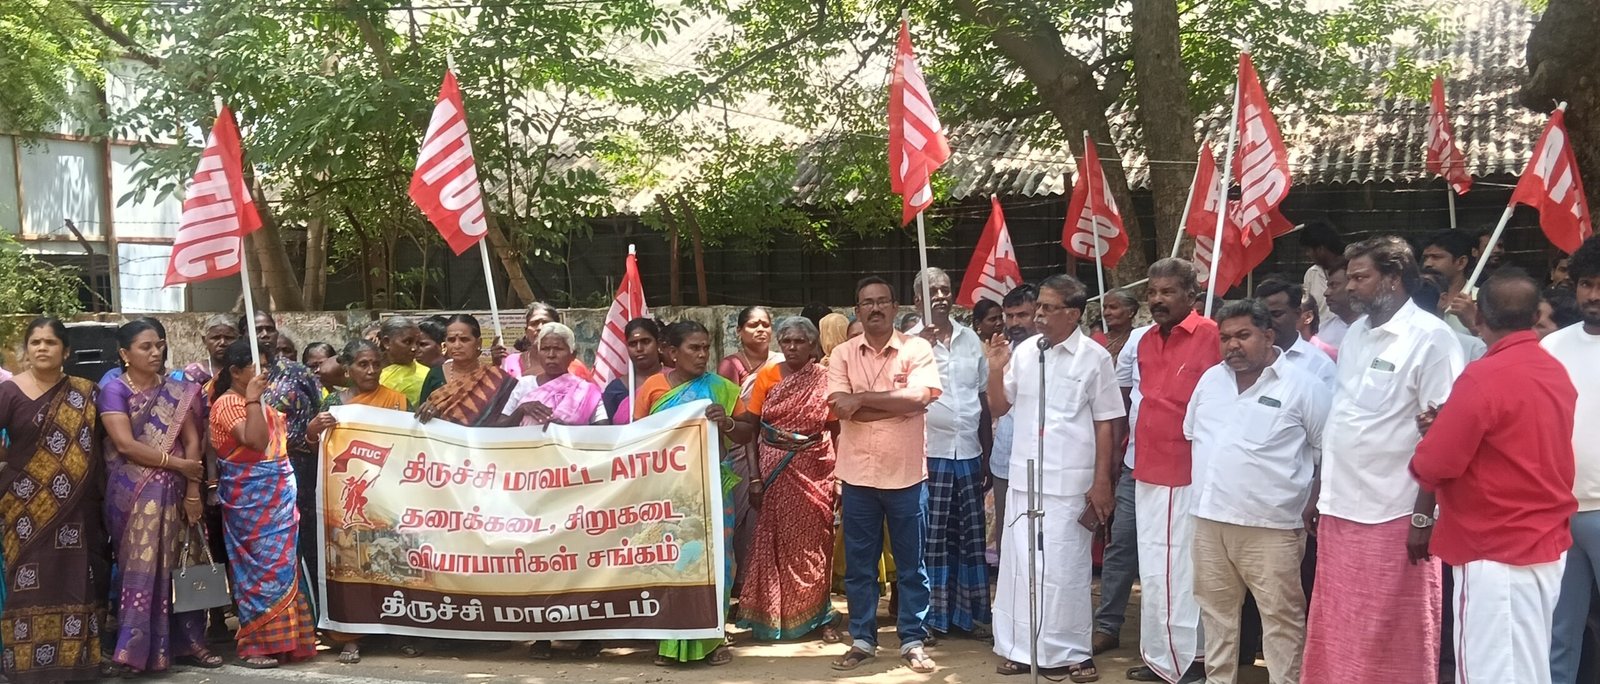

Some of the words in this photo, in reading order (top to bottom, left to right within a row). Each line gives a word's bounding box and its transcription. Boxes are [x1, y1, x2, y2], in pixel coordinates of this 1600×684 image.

[350, 446, 382, 460] AITUC
[399, 452, 497, 489] திருச்சி
[503, 463, 603, 491] மாவட்ட
[611, 446, 686, 481] AITUC
[399, 505, 556, 533] தரைக்கடை,
[565, 501, 683, 535] சிறுகடை
[408, 545, 578, 573] வியாபாரிகள்
[587, 535, 679, 567] சங்கம்
[380, 590, 486, 623] திருச்சி
[493, 591, 660, 623] மாவட்டம்
